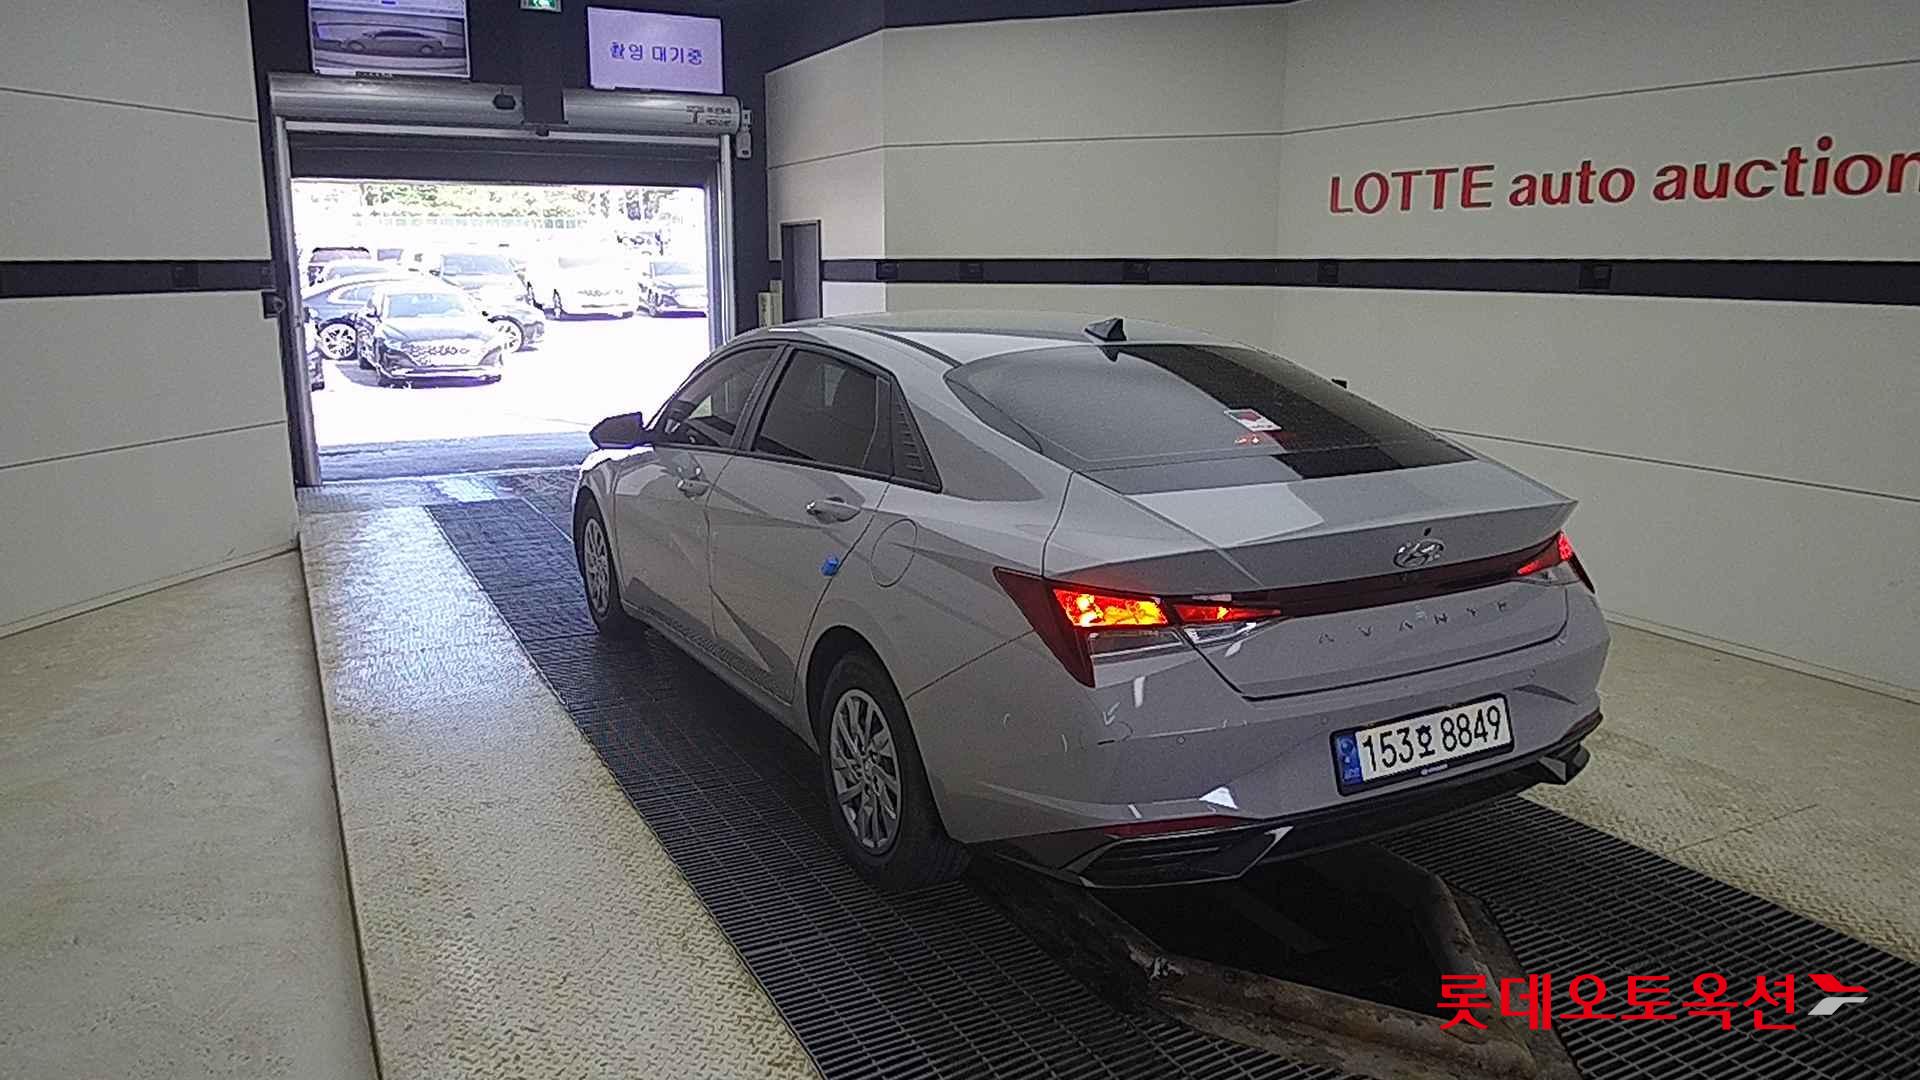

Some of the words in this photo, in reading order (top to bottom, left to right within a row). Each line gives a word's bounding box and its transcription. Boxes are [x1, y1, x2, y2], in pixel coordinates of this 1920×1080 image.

[1330, 165, 1495, 213] LOTTE
[1509, 160, 1635, 207] auto
[1440, 705, 1501, 752] 8849
